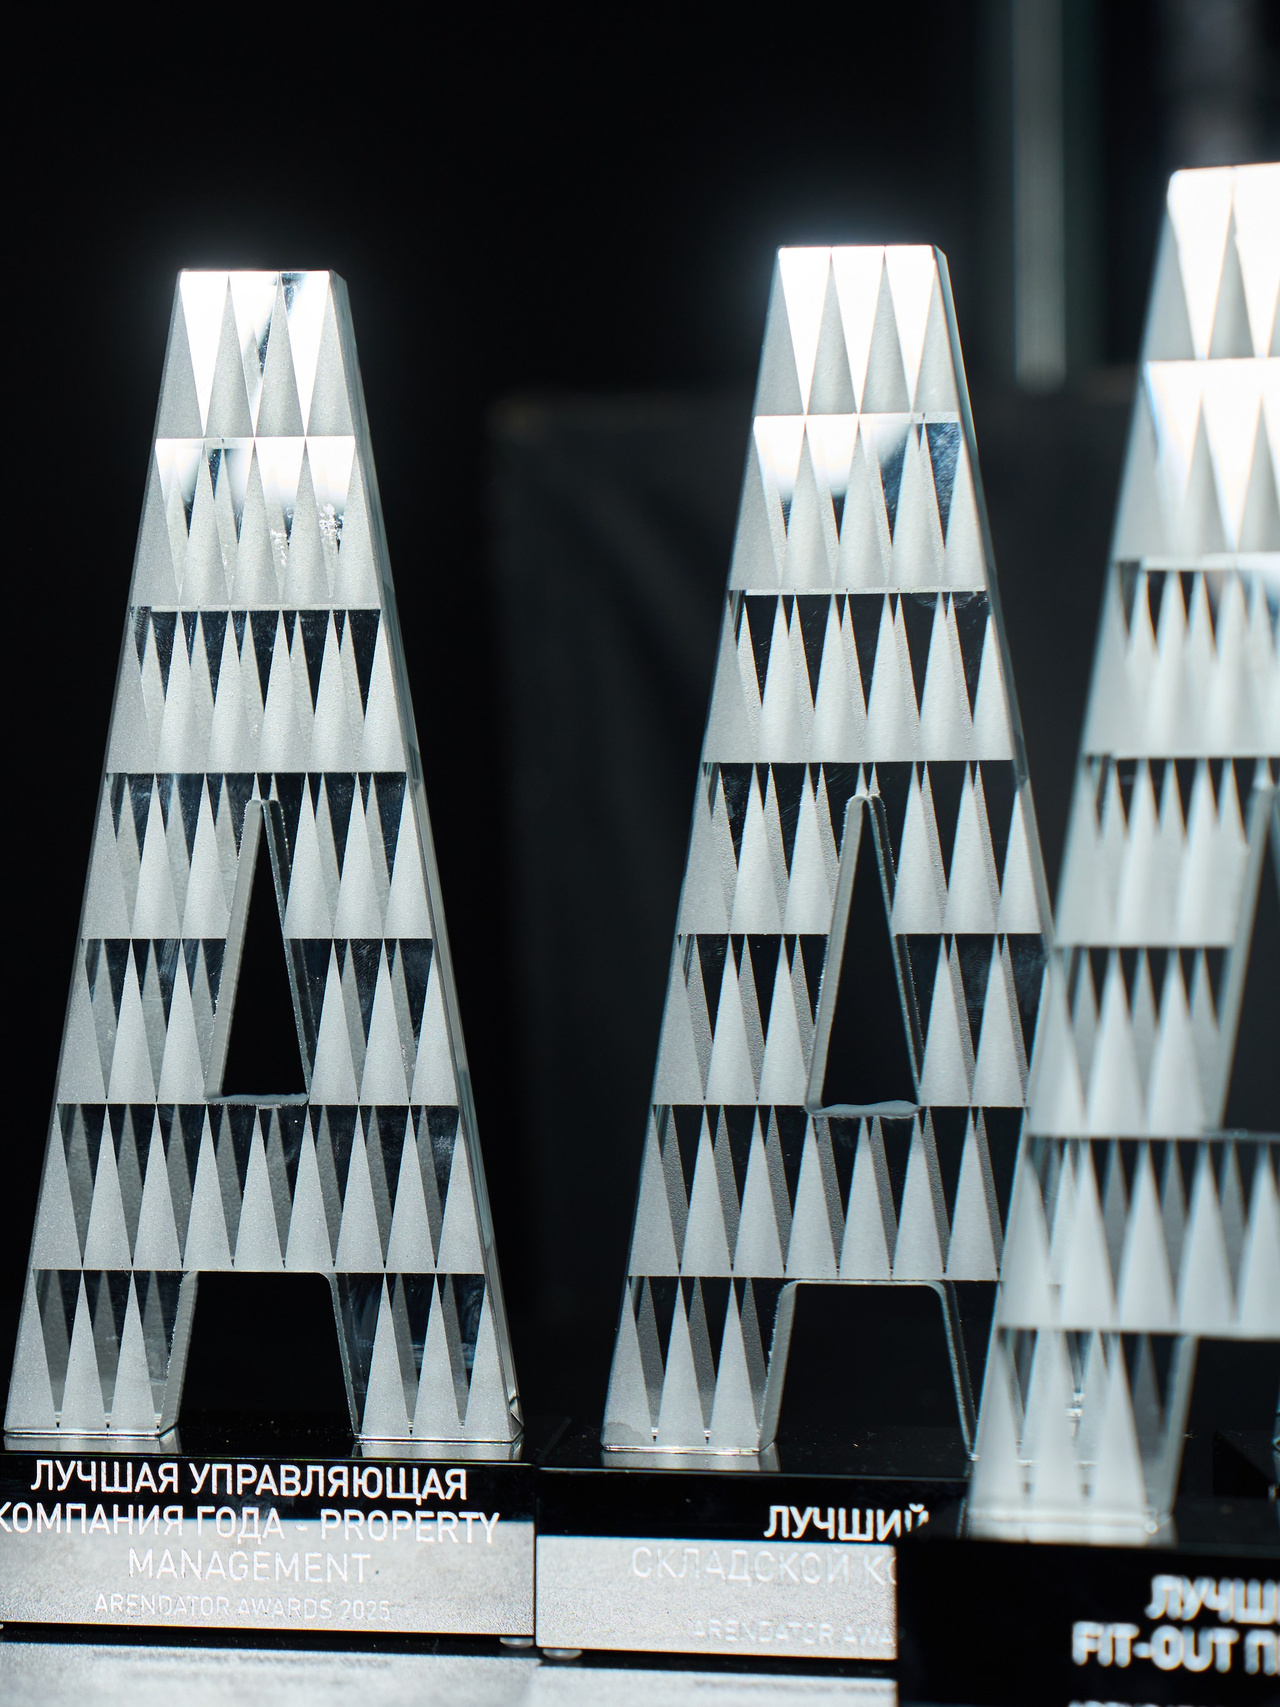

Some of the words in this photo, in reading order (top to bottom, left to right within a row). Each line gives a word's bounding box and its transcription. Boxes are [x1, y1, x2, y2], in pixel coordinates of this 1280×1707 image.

[30, 1459, 179, 1494] ЛУЧШАЯ
[188, 1462, 468, 1506] УПРАВЛЯЮЩАЯ
[196, 1505, 285, 1544] ГОДА
[320, 1508, 500, 1545] PROPERTY
[763, 1503, 929, 1542] ЛУЧШИЙ
[128, 1547, 372, 1584] MANAGEMENT
[631, 1545, 850, 1587] СКЛАДСКОЙ
[94, 1592, 230, 1617] ARENDATOR
[238, 1597, 333, 1620] AWARDS
[340, 1600, 391, 1622] 2025
[1145, 1574, 1280, 1625] ЛУЧШ
[1072, 1620, 1239, 1673] FIT-OUT
